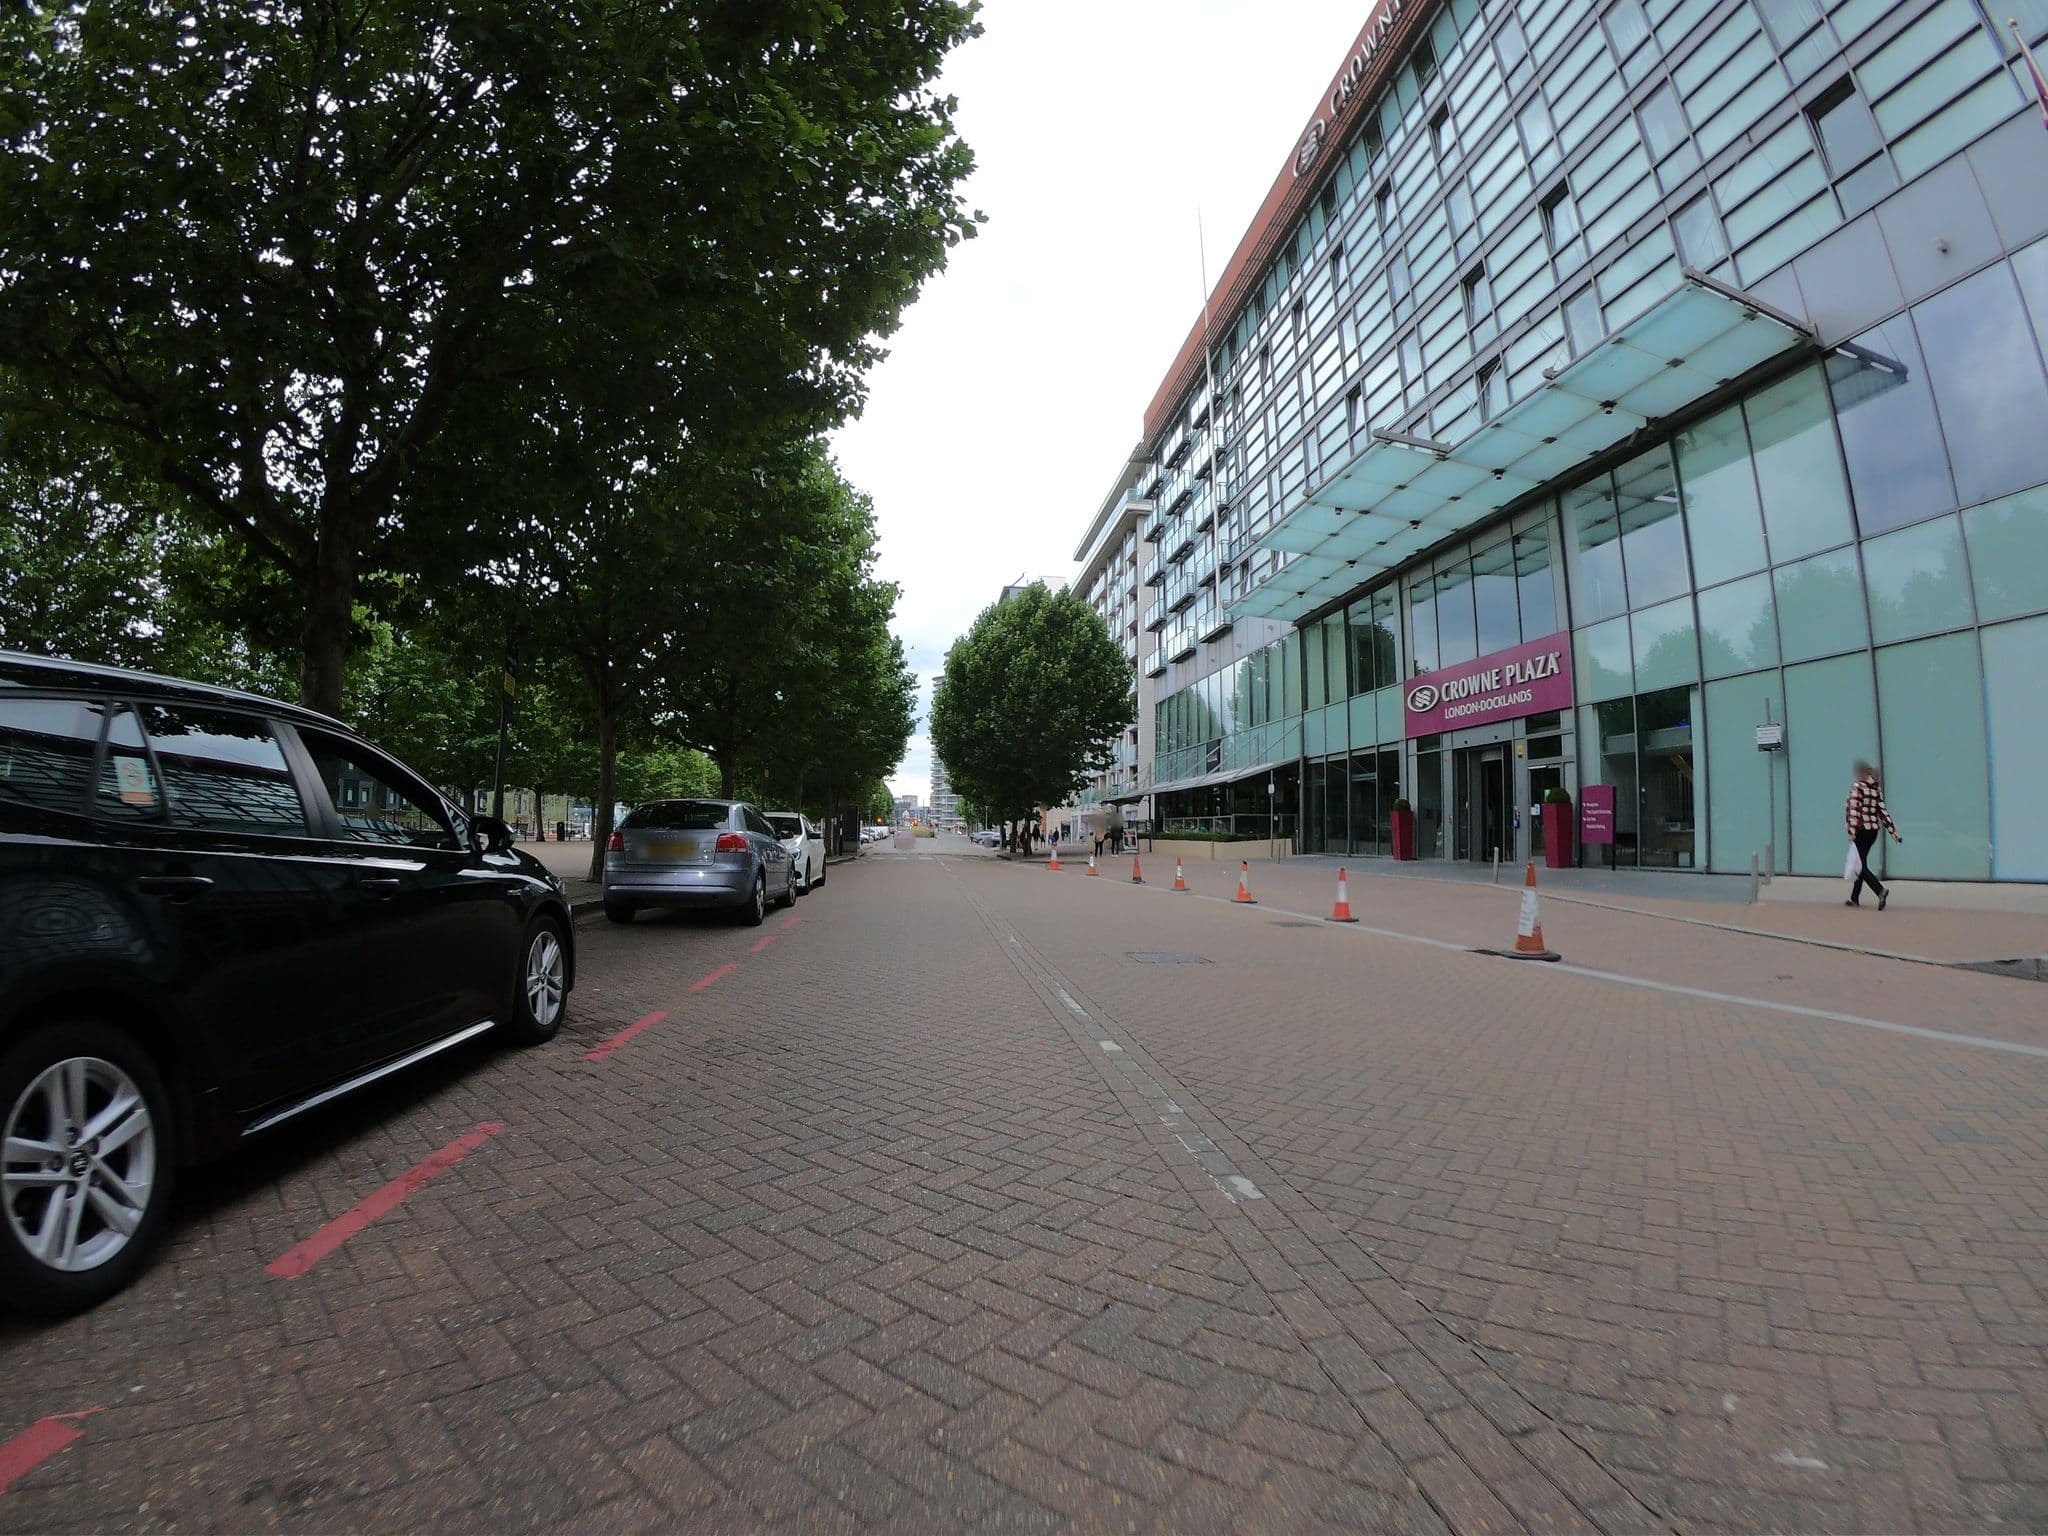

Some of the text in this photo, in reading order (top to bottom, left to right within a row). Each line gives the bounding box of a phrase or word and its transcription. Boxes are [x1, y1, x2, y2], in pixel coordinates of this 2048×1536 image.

[1441, 652, 1561, 702] CROWNE PLAZA
[1444, 689, 1532, 719] LONDON-DOCKLANDS
